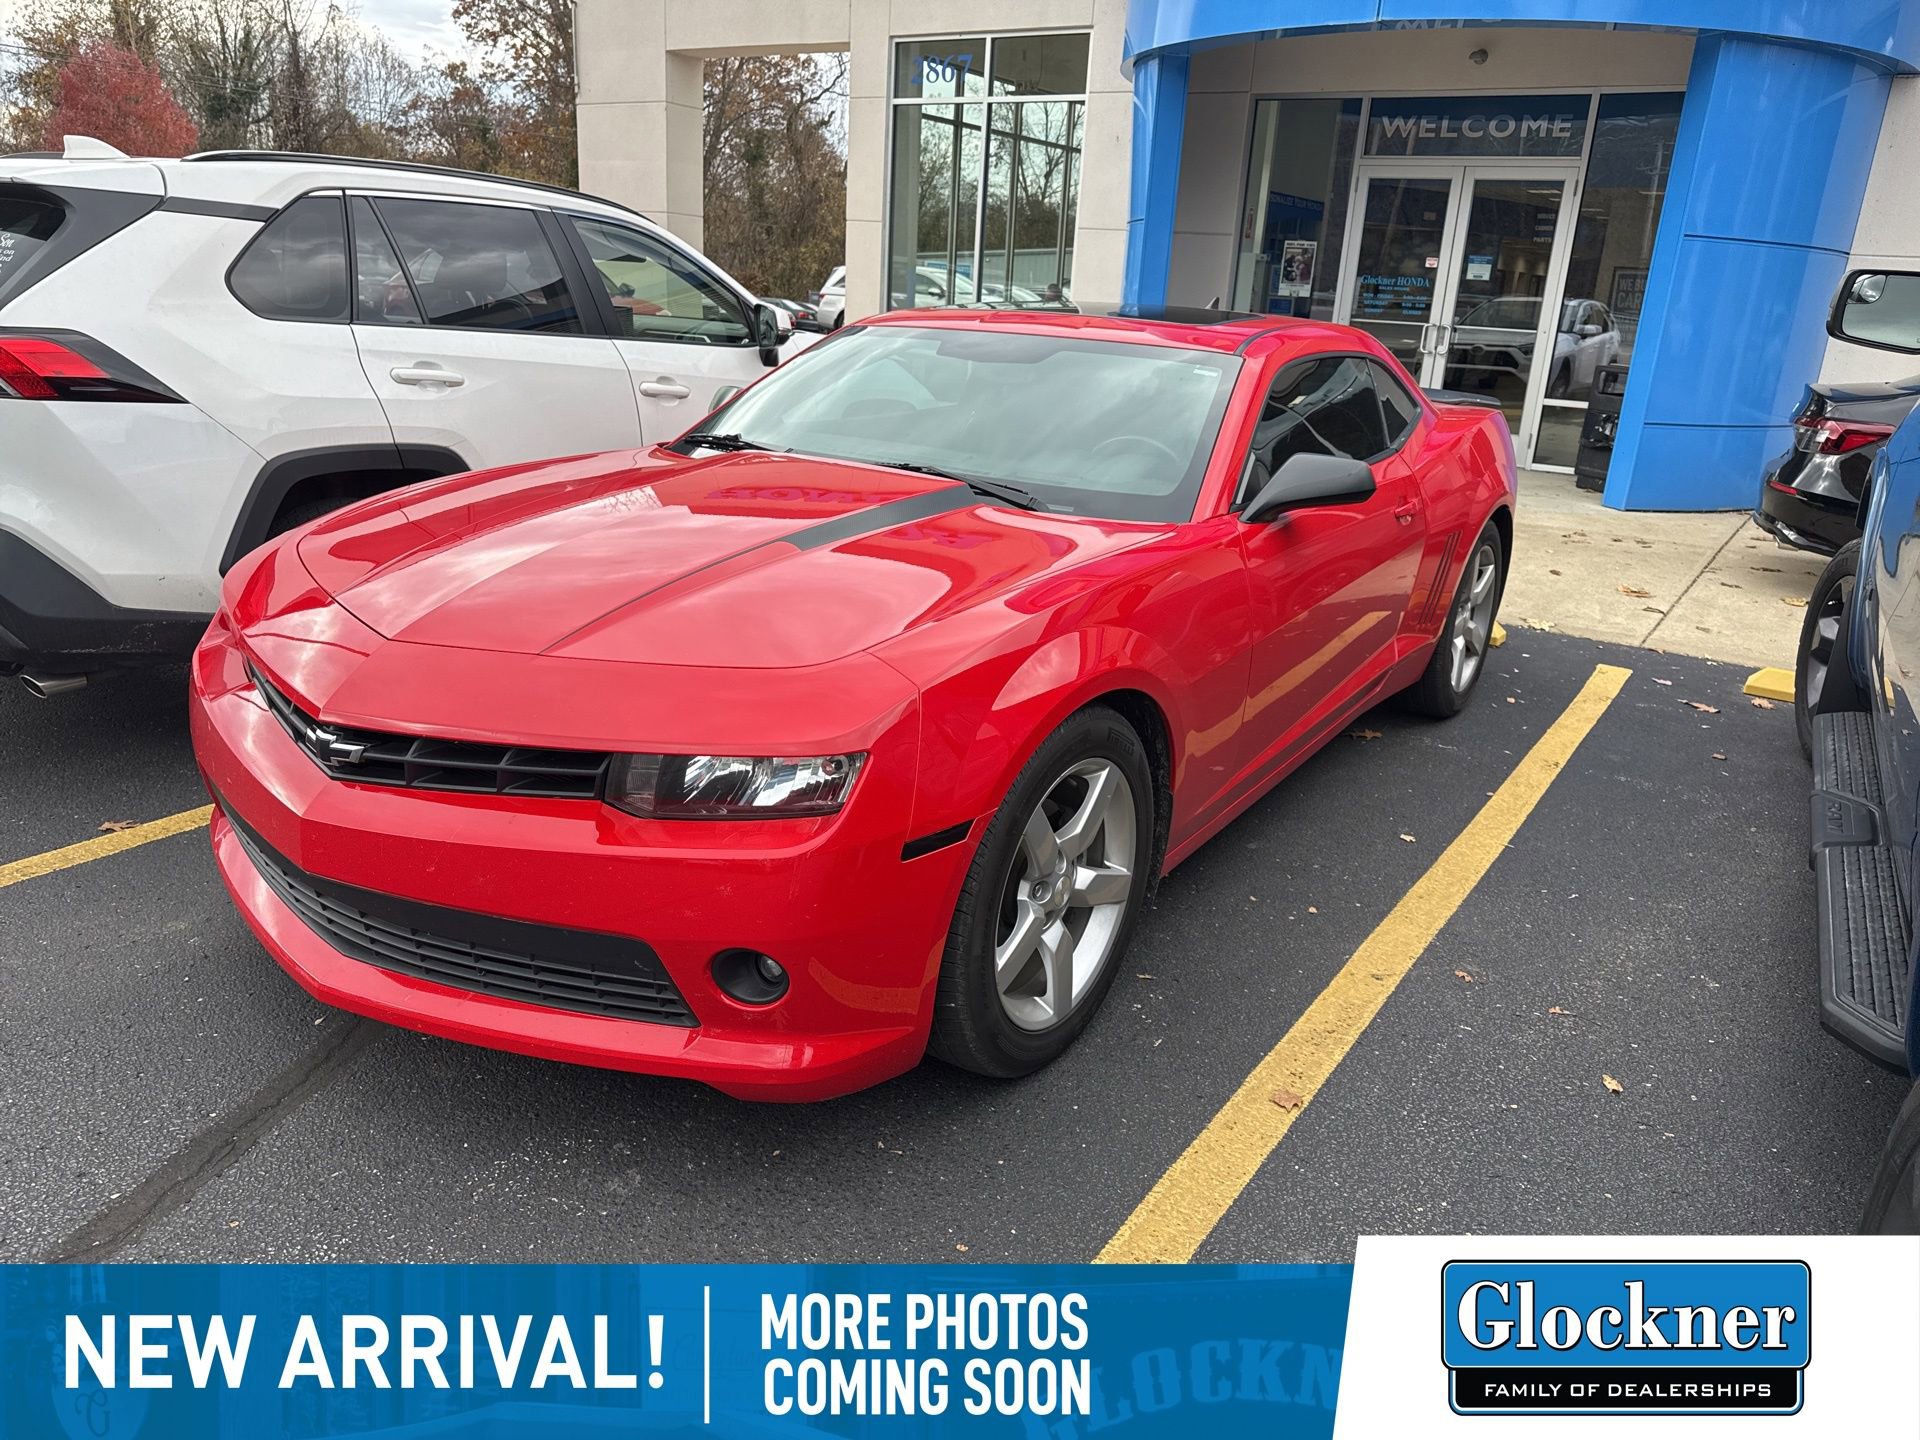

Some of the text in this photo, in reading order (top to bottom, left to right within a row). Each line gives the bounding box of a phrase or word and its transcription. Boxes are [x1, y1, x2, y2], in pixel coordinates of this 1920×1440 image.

[911, 53, 973, 84] 2867
[1382, 113, 1574, 138] WELCOME
[1360, 275, 1430, 288] Glockner HONDA
[1619, 278, 1634, 291] WE
